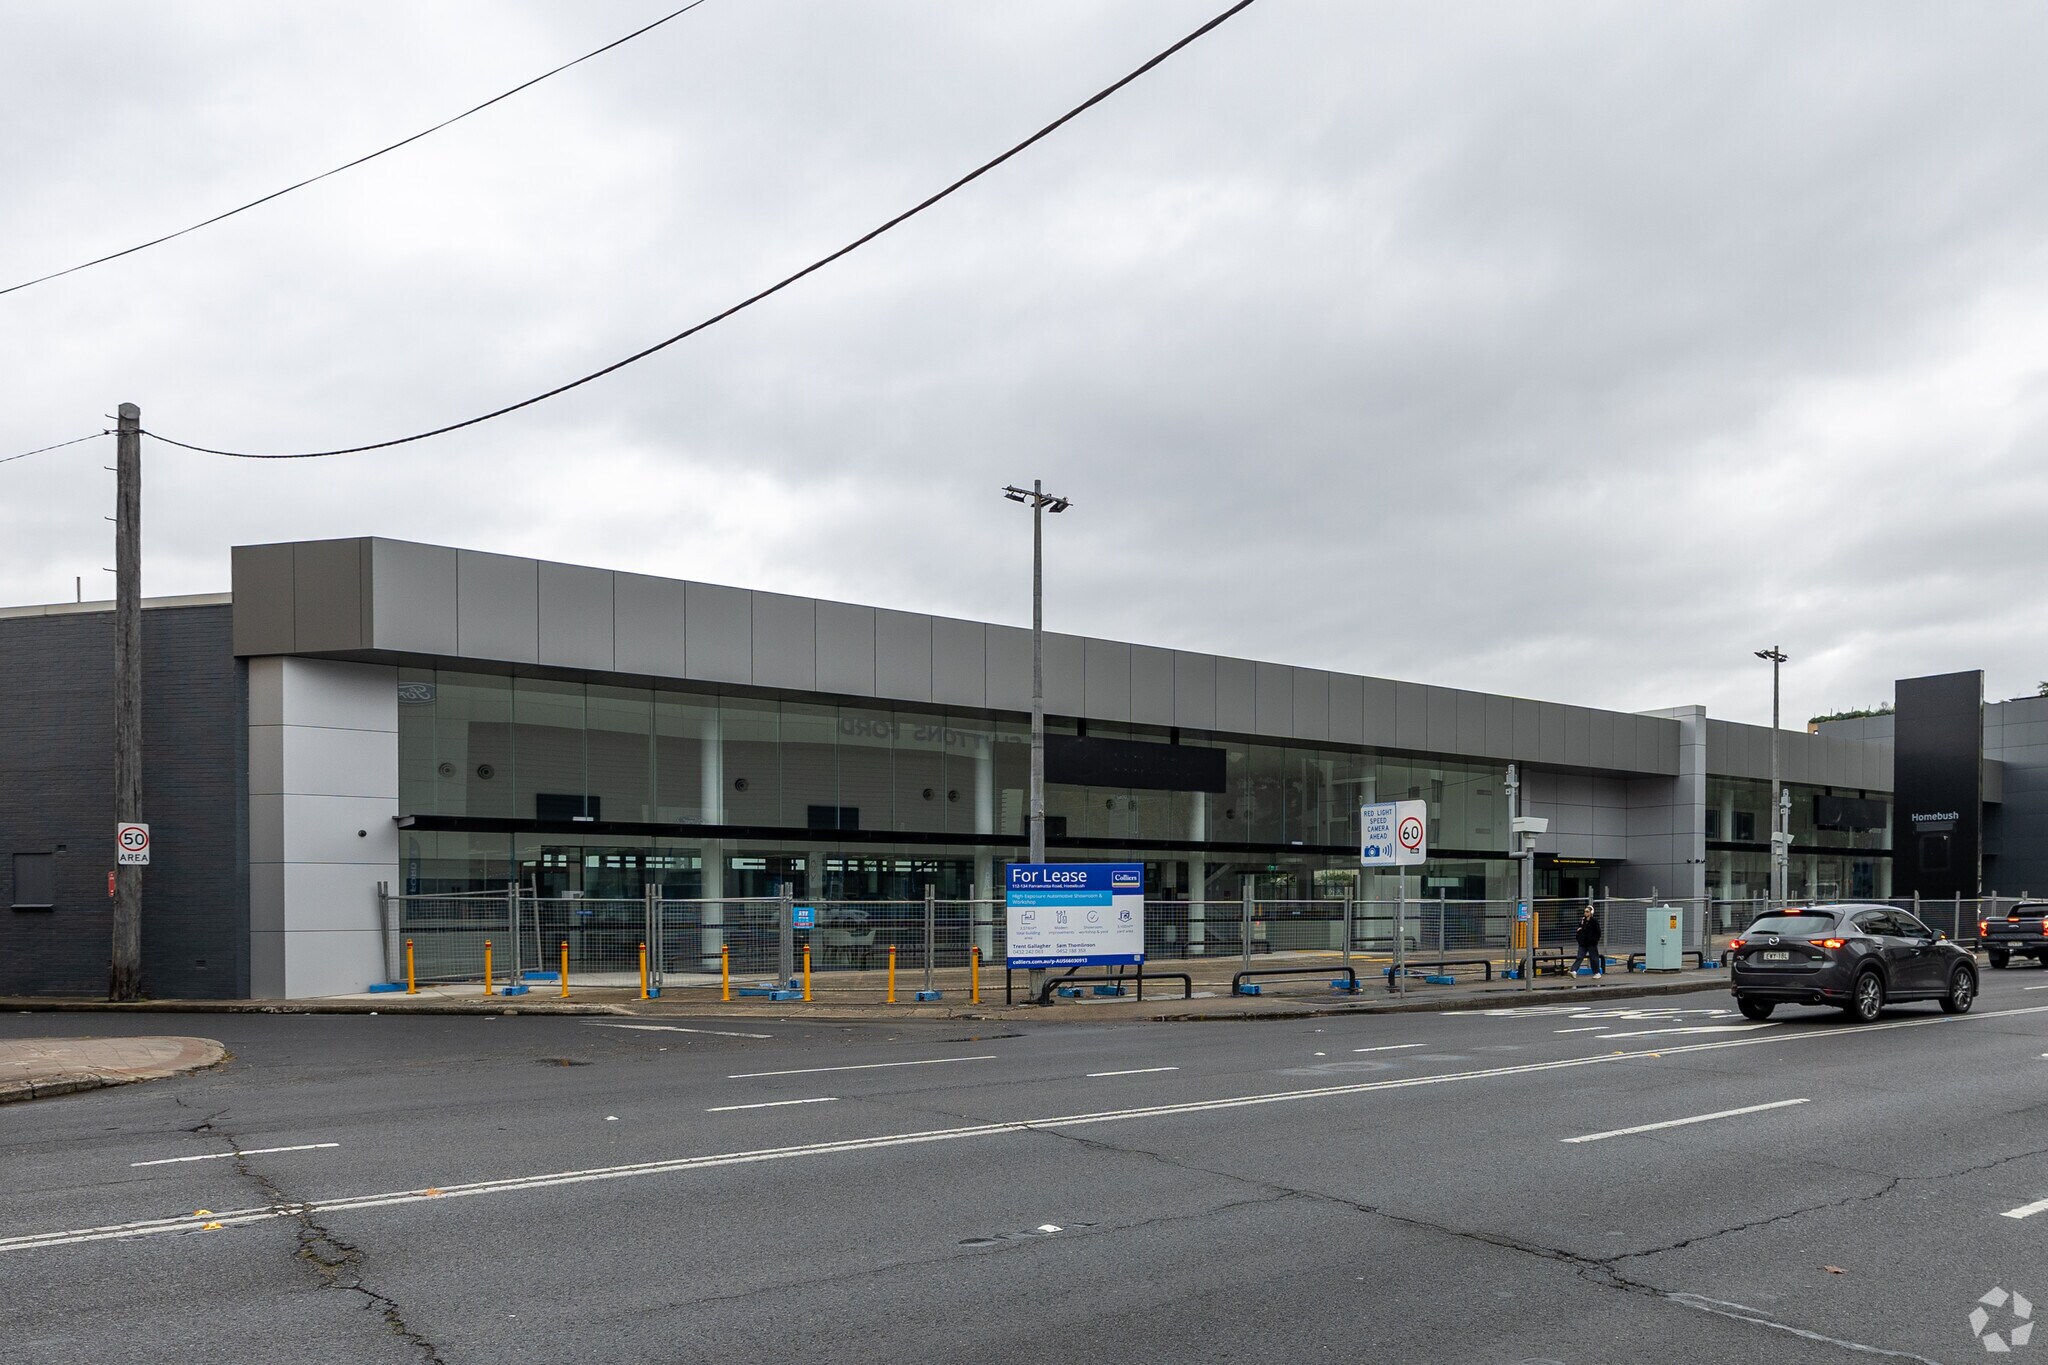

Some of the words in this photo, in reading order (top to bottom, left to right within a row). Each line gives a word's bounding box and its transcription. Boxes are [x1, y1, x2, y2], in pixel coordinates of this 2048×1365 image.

[1911, 811, 1959, 822] Homebush
[124, 833, 145, 846] 50
[1403, 826, 1419, 840] 60
[120, 853, 149, 862] AREA
[1012, 868, 1038, 882] For
[1043, 868, 1087, 882] Lease
